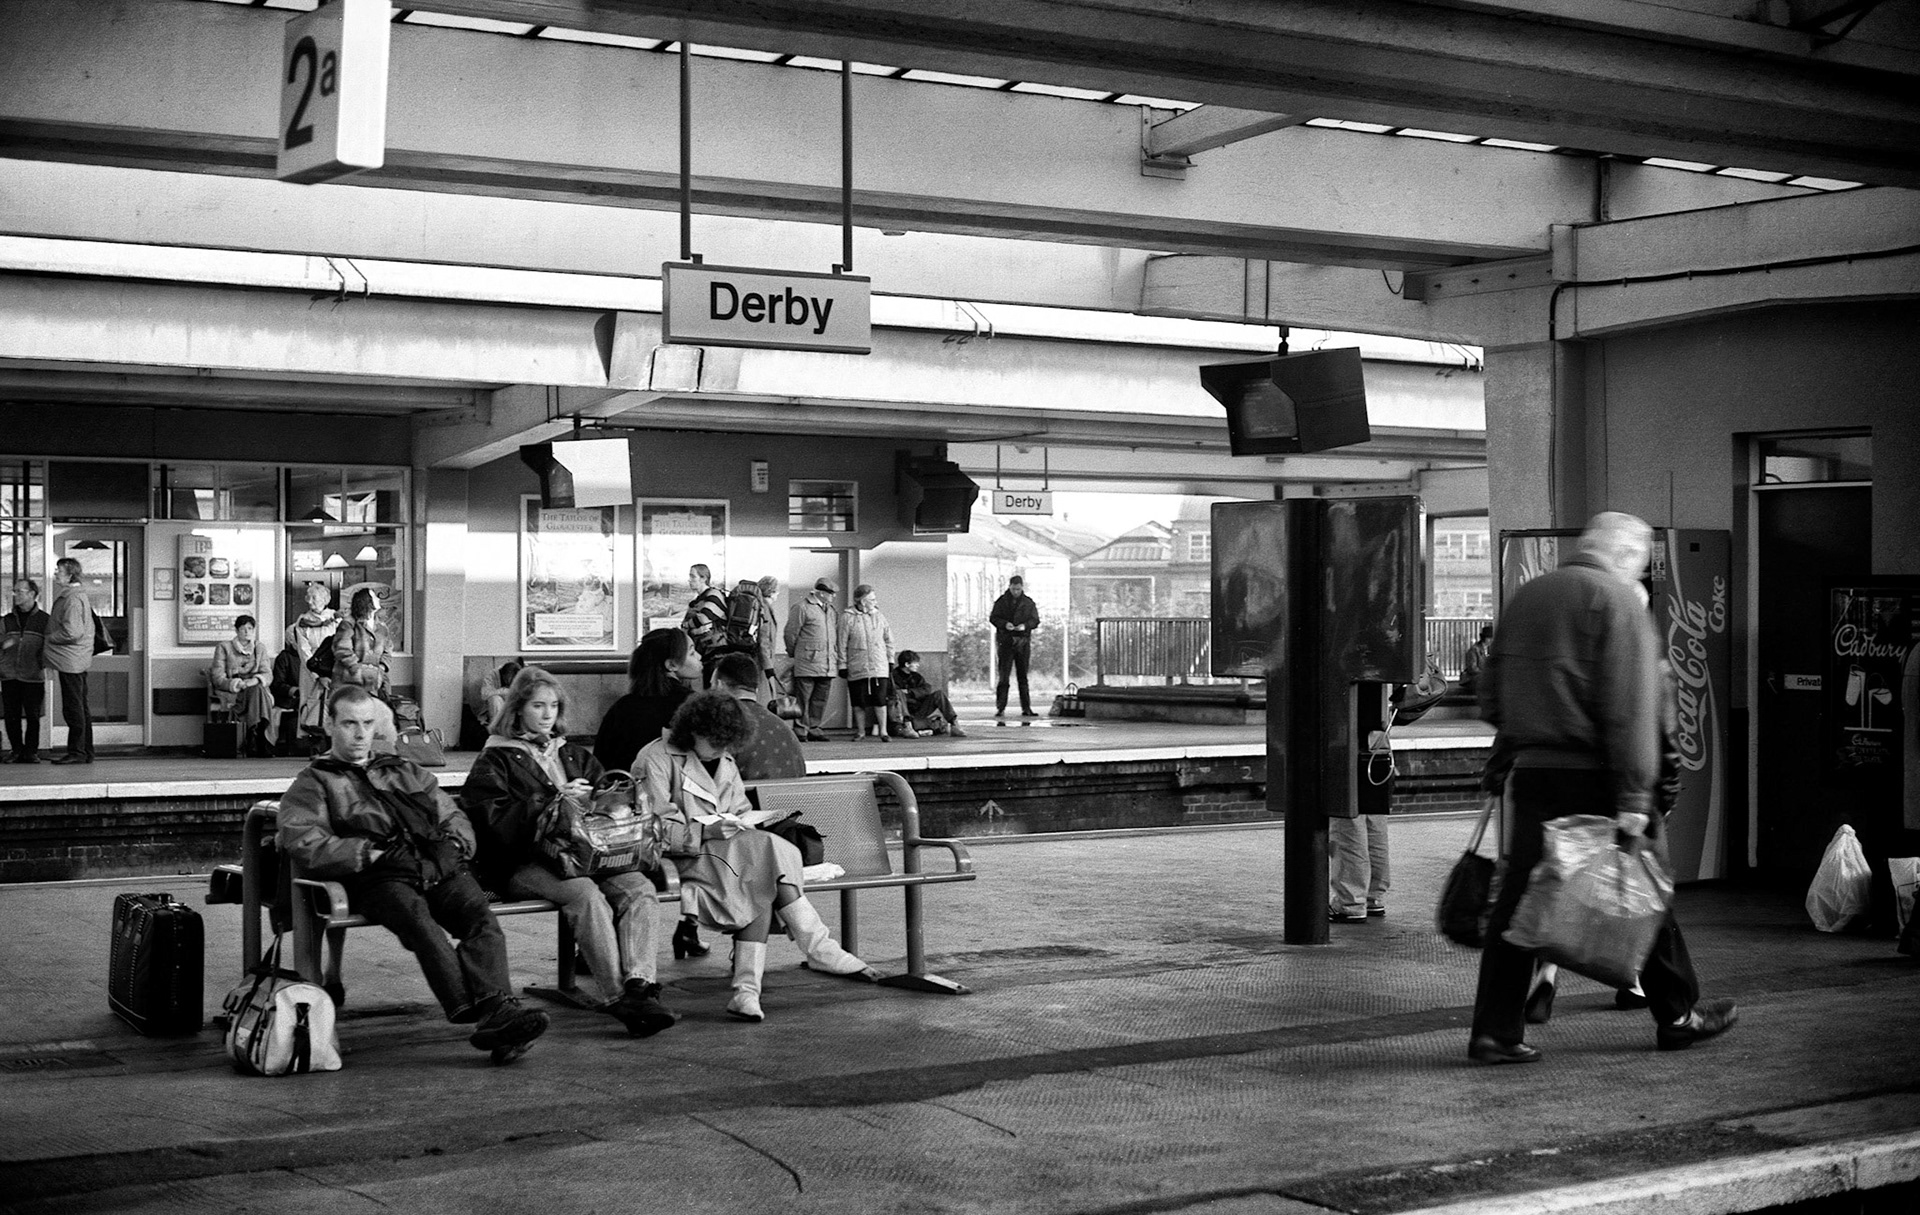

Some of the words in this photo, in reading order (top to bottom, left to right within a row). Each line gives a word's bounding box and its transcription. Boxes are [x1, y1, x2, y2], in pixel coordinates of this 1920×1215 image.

[284, 35, 337, 151] 2a
[709, 281, 833, 336] Derby
[1005, 494, 1043, 511] Derby
[541, 513, 557, 521] THE
[559, 513, 587, 522] TAILOR
[1708, 574, 1726, 634] Coke
[1834, 623, 1908, 663] Cadbury
[1796, 677, 1821, 687] Privat
[1240, 765, 1253, 780] 2
[598, 852, 634, 868] PUMA
